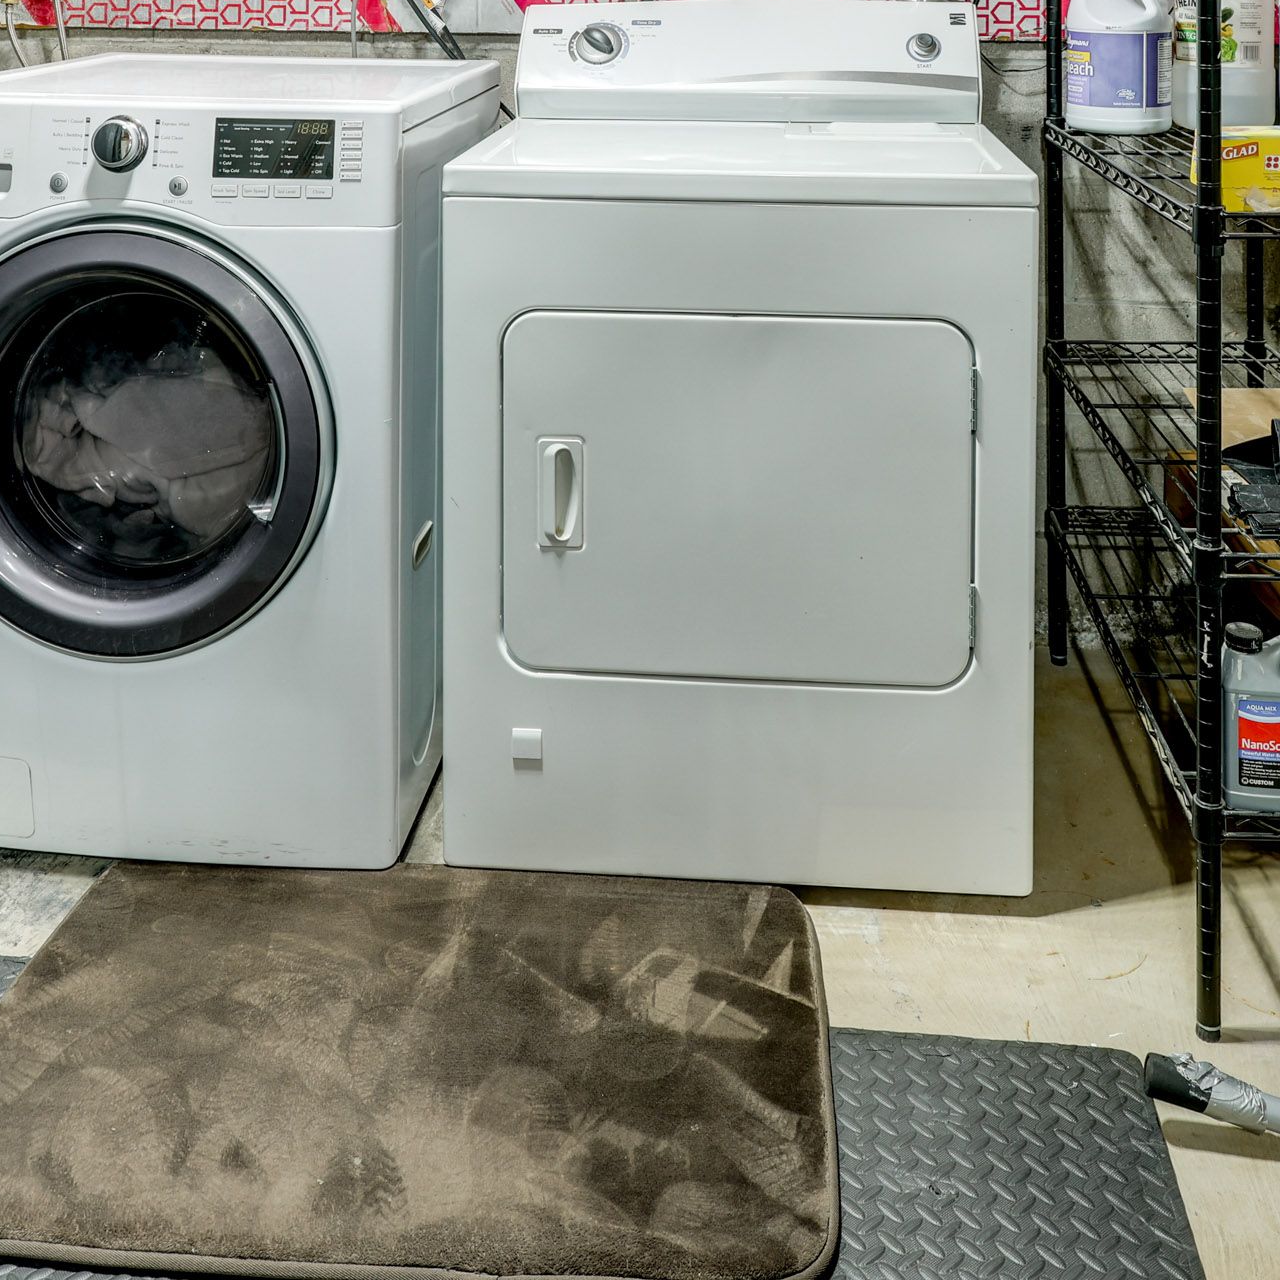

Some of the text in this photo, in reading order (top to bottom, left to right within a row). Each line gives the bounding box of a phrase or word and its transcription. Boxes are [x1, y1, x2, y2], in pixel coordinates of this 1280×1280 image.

[1222, 144, 1258, 160] GLAD
[1246, 704, 1264, 712] AQUA
[1249, 778, 1275, 786] CUSTOM
